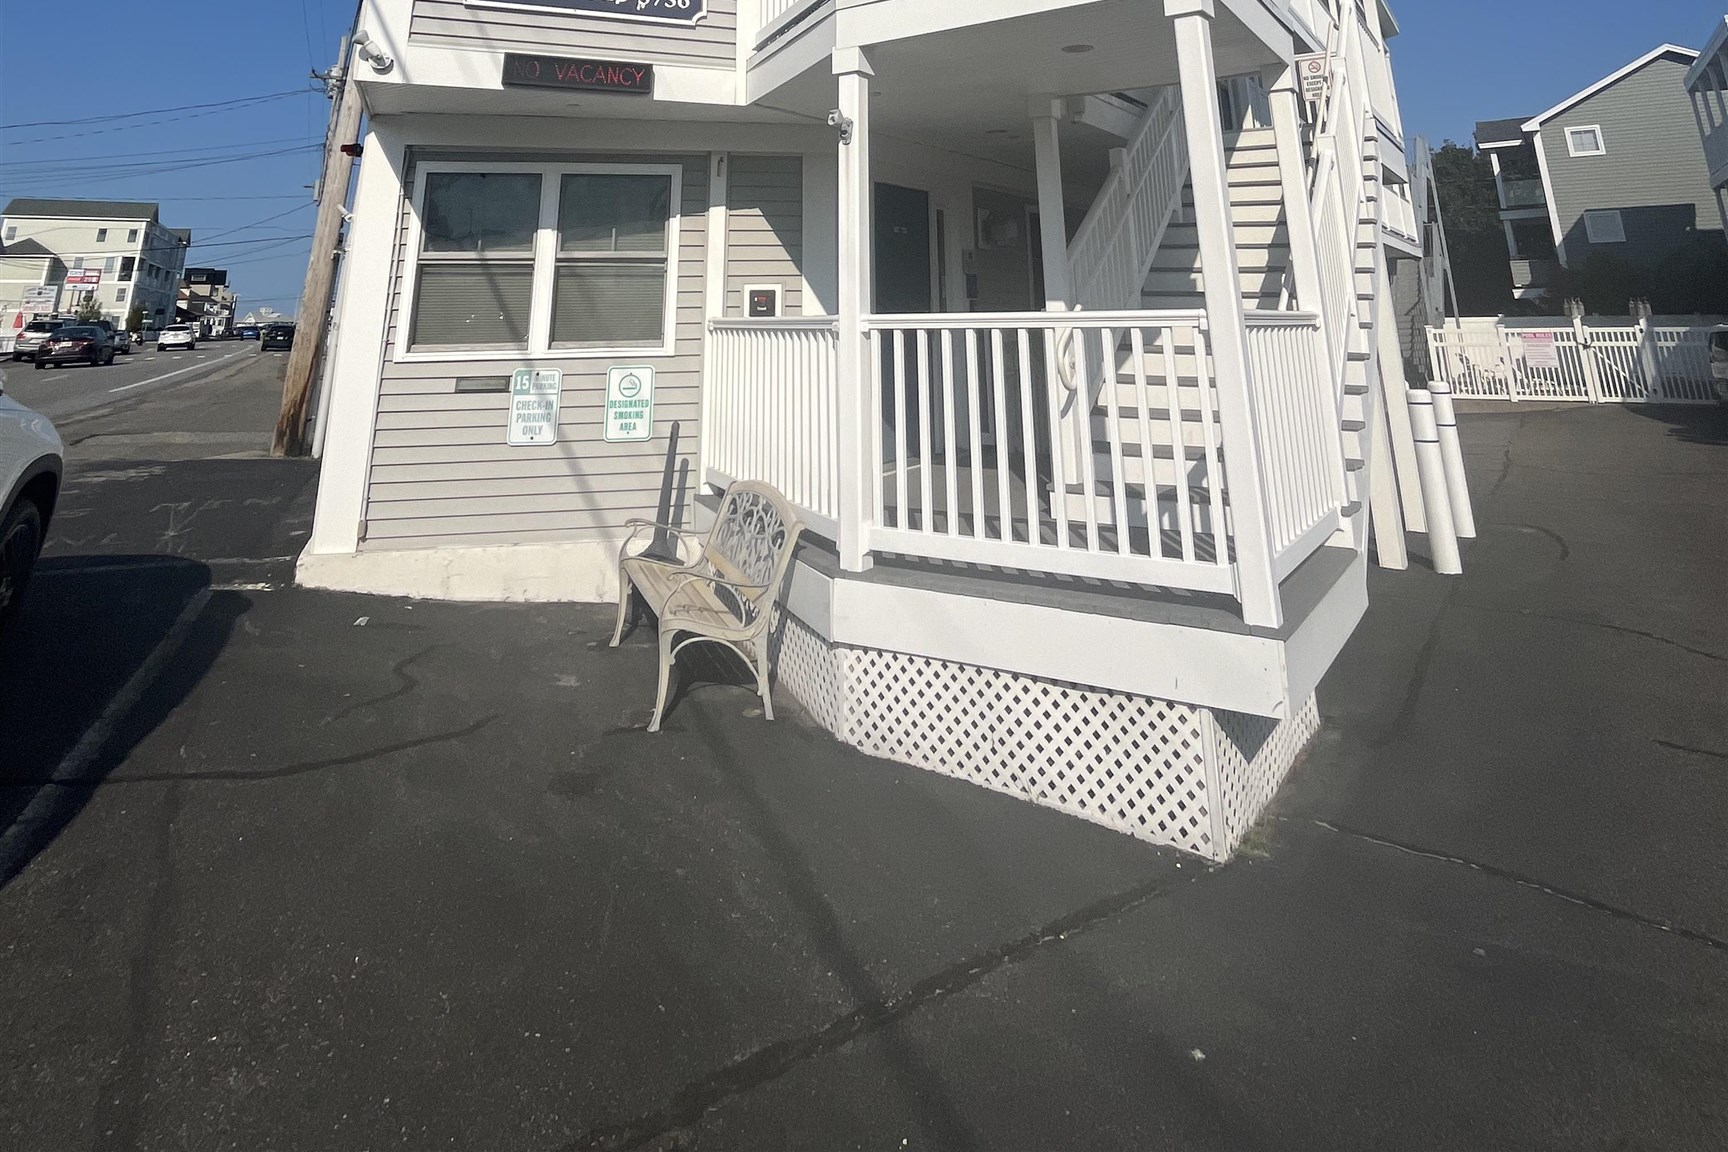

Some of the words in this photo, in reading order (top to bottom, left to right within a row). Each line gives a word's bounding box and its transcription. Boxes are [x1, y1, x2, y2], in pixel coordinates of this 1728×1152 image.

[513, 58, 540, 79] NO
[554, 62, 646, 87] VACANCY
[515, 375, 530, 390] 15
[532, 382, 557, 391] PARKING
[515, 399, 554, 411] CHECK-IN
[609, 399, 650, 409] DESIGNATED
[516, 412, 552, 423] PARKING
[613, 410, 644, 420] SMOKING
[522, 425, 544, 436] ONLY
[619, 422, 637, 431] AREA
